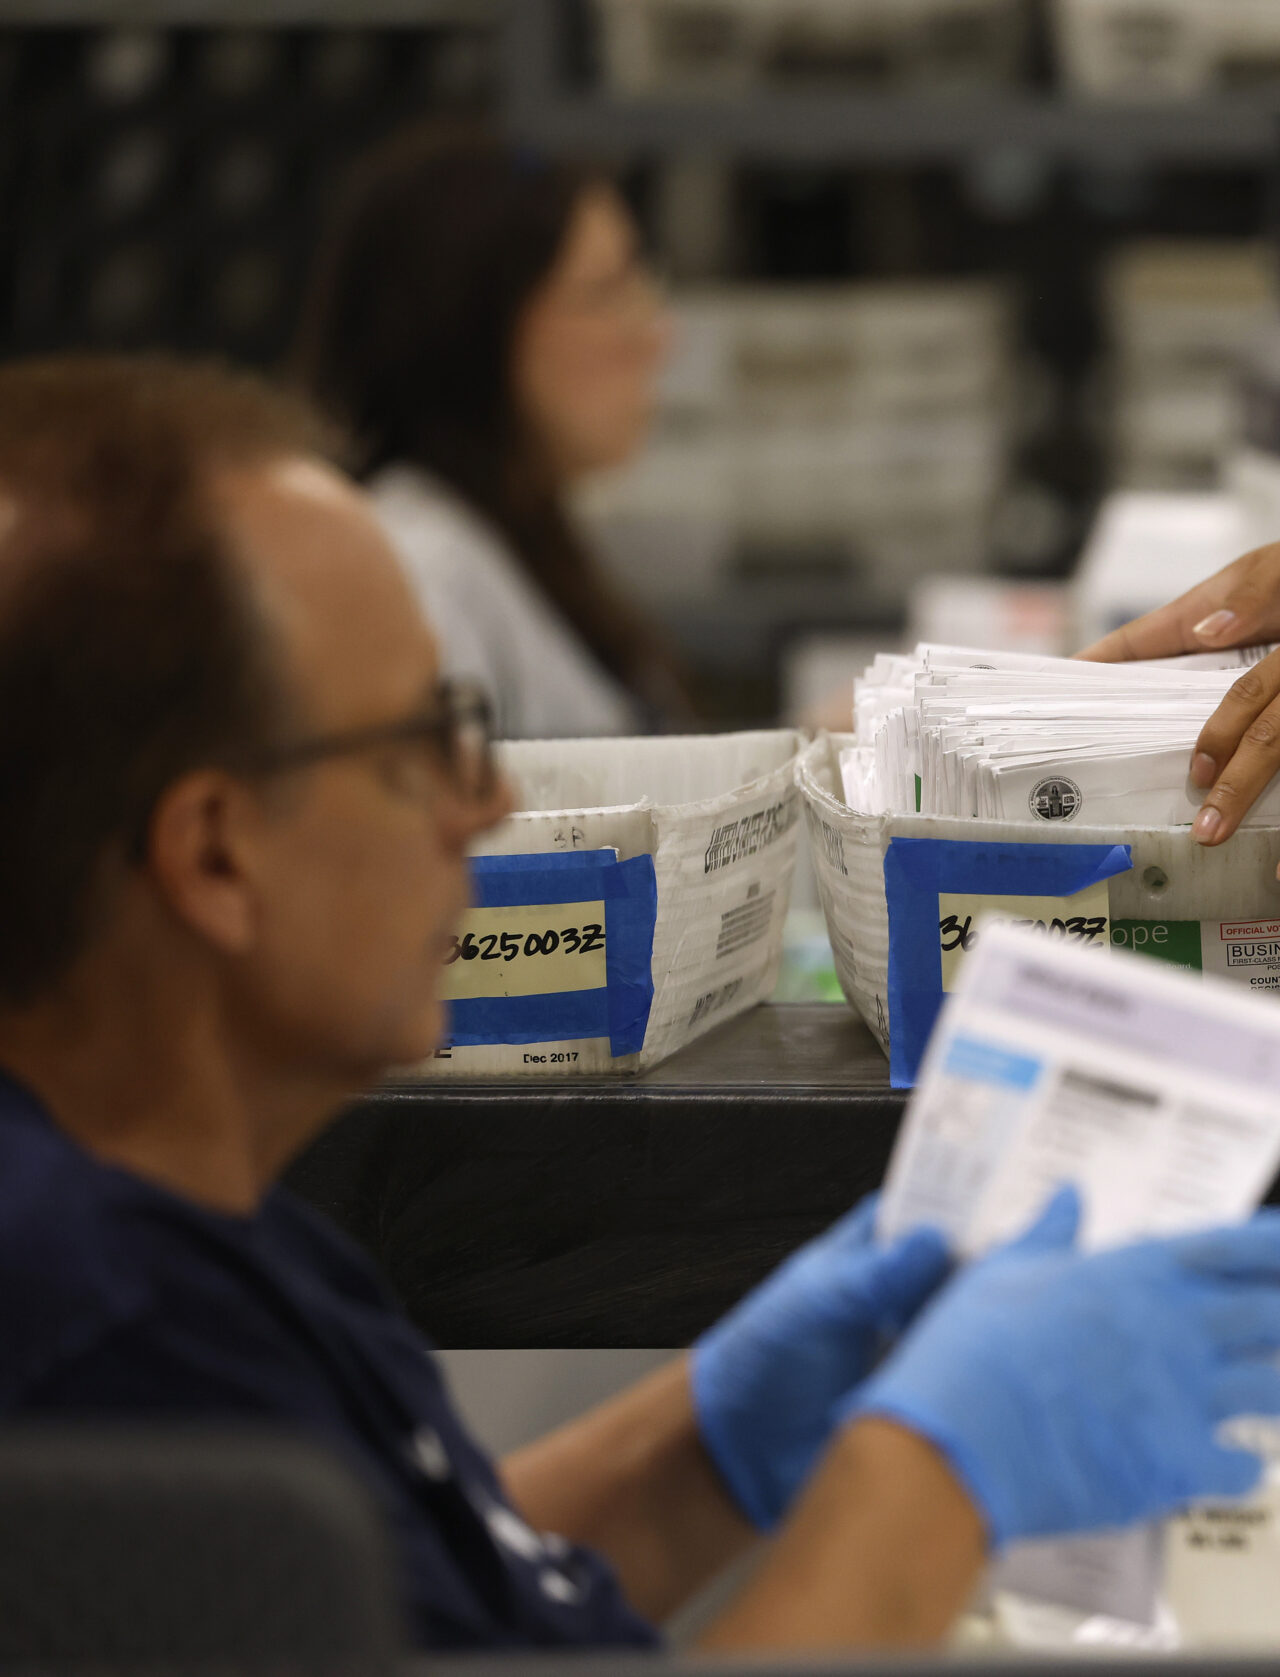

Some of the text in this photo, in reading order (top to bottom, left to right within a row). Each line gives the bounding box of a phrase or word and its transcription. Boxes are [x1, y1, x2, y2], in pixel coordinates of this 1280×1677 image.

[1226, 927, 1265, 935] OFFICIAL
[1233, 956, 1277, 964] FIRST-CLASS
[523, 1052, 579, 1064] Dec 2017
